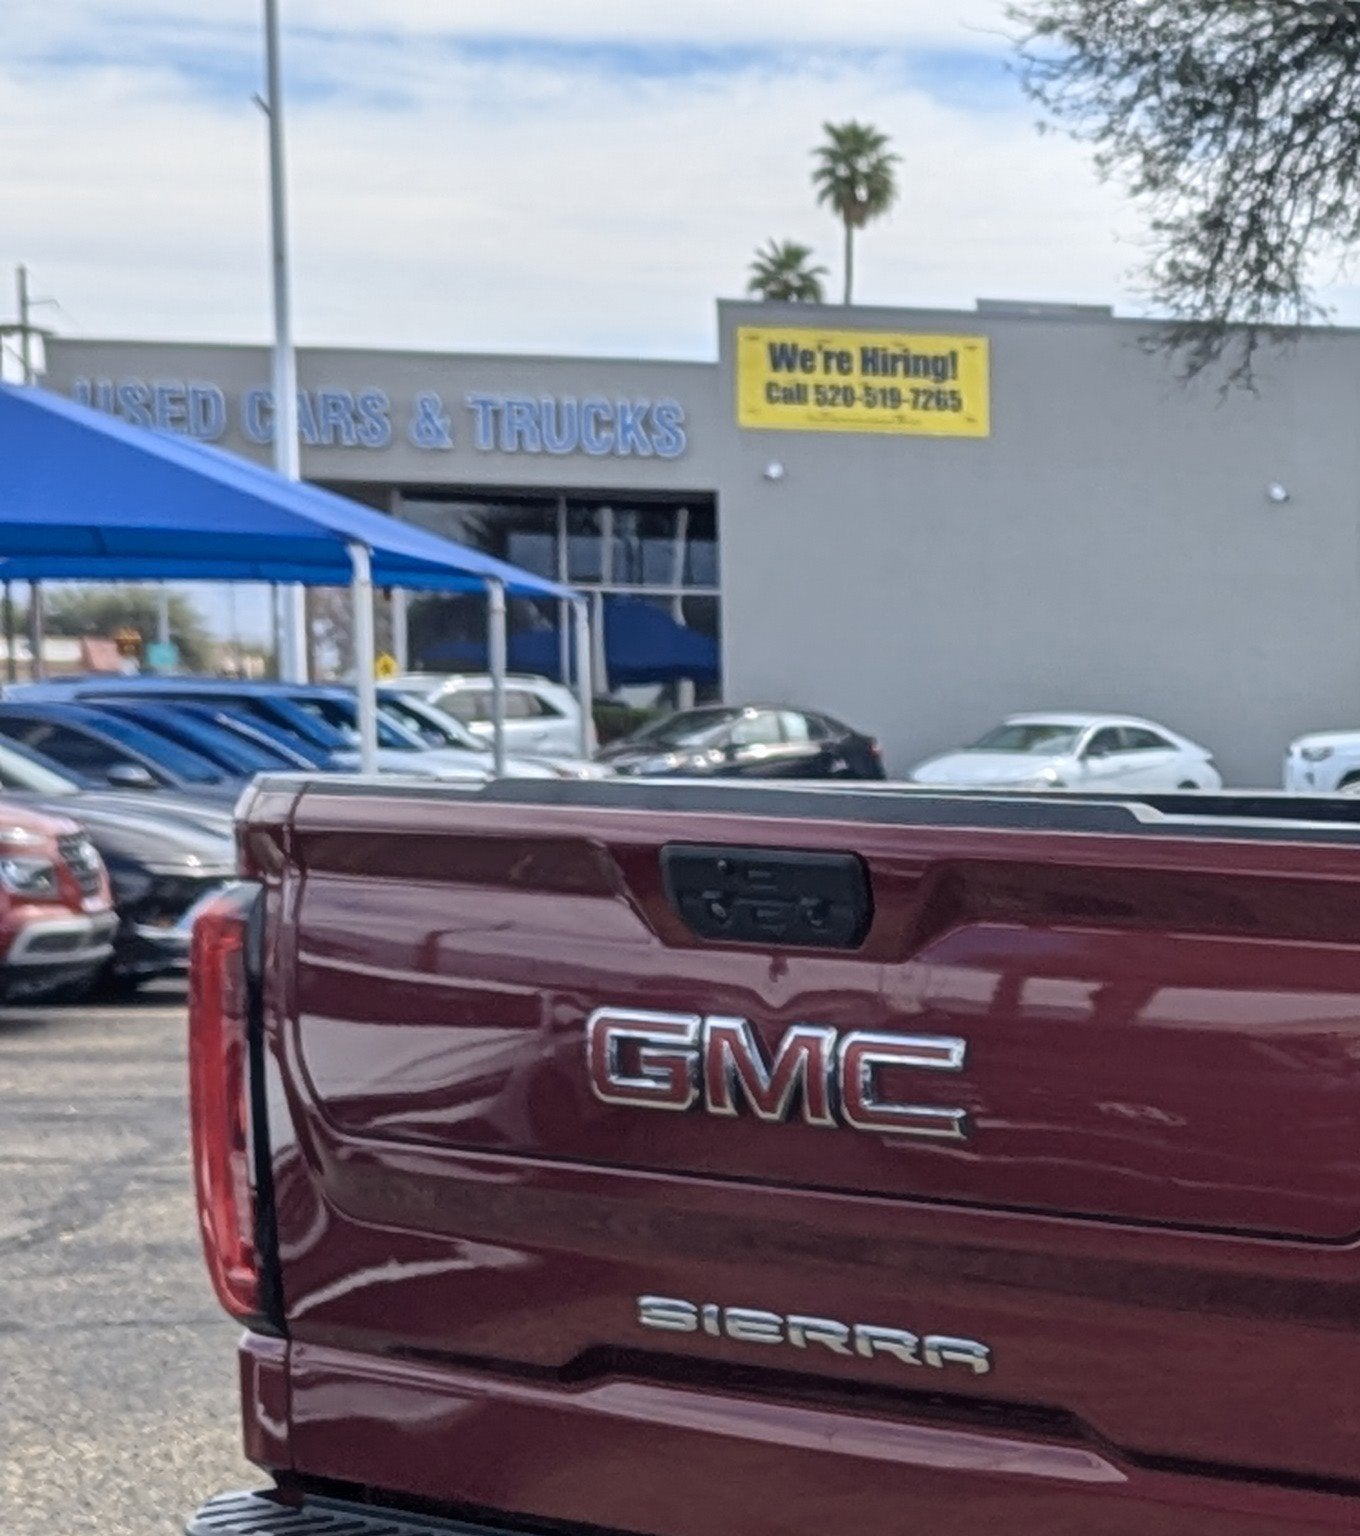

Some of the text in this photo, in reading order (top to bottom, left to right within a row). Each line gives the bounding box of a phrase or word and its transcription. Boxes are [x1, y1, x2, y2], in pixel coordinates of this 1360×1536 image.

[765, 381, 808, 406] Call
[767, 342, 958, 383] We're Hiring!
[411, 391, 452, 451] &
[468, 392, 687, 458] TRUCKS
[587, 1006, 968, 1141] GMC
[637, 1295, 991, 1375] SIERRA
